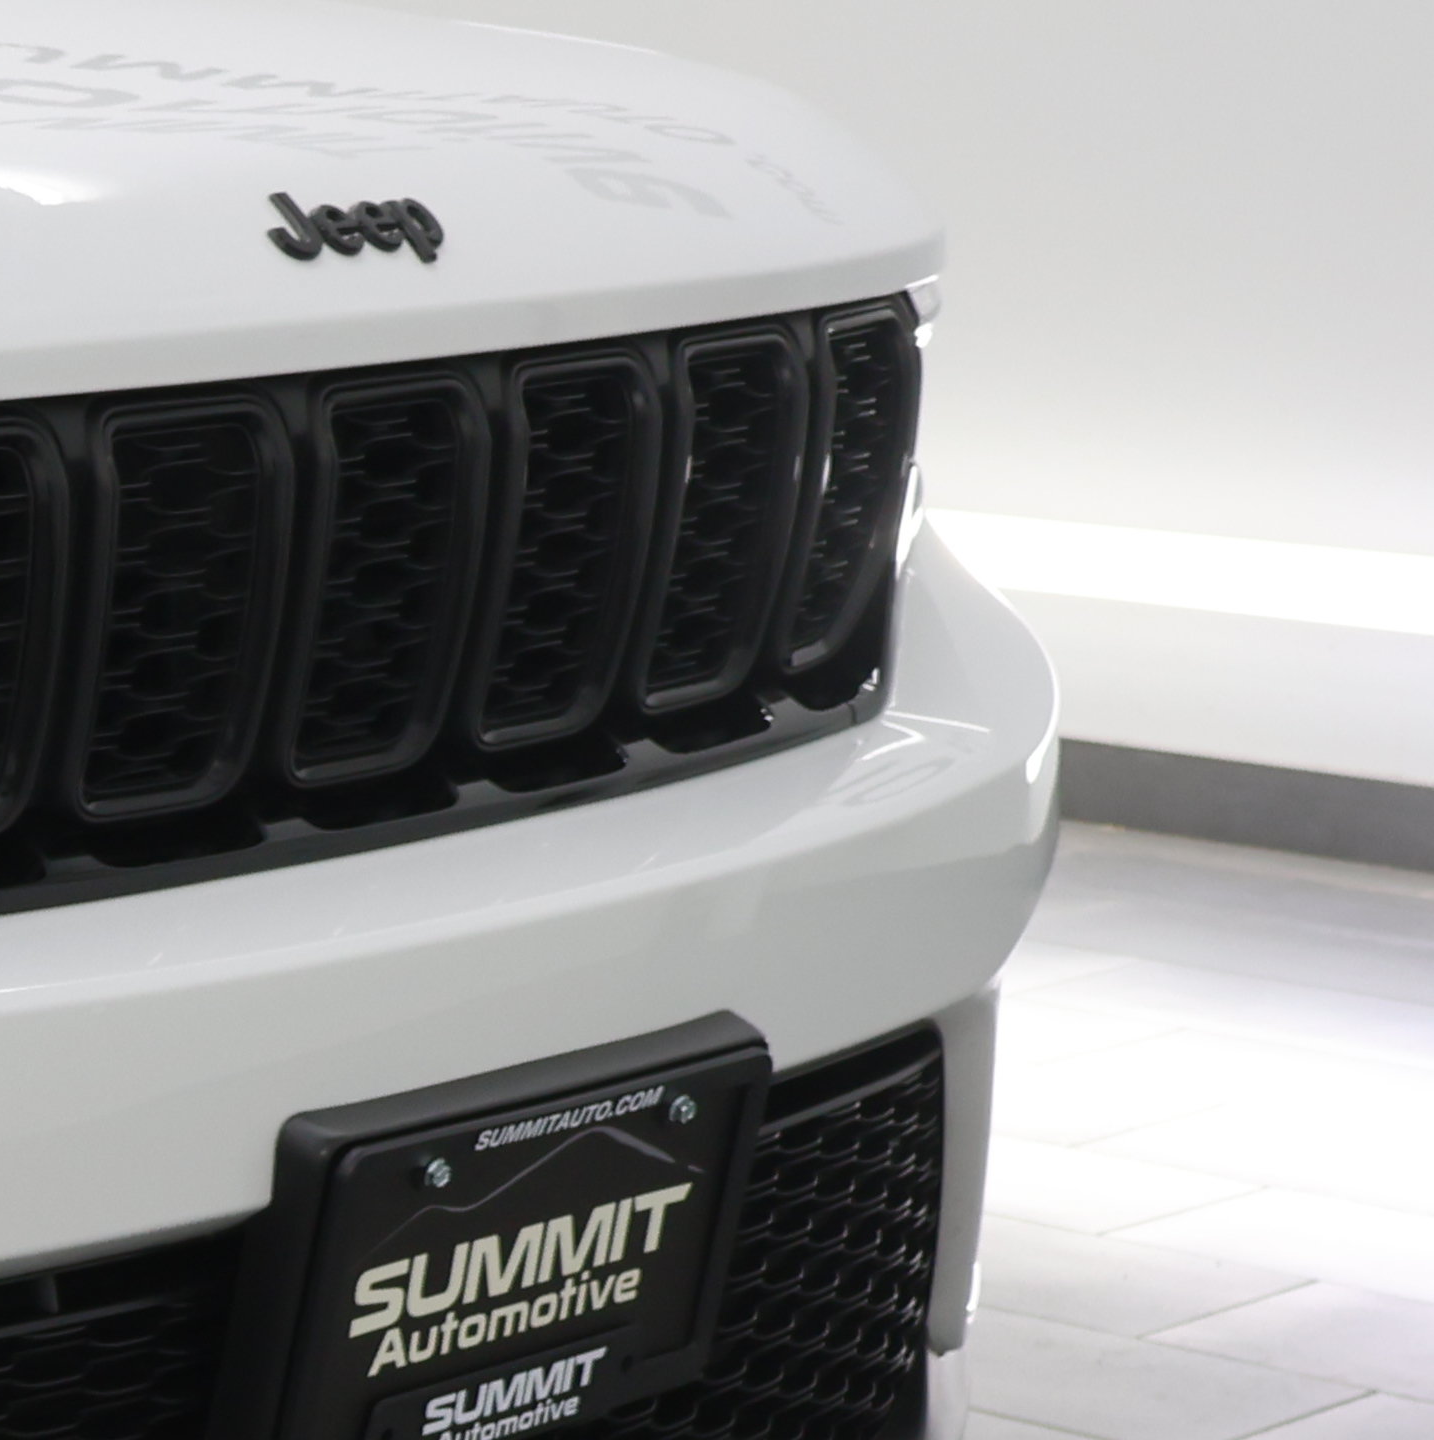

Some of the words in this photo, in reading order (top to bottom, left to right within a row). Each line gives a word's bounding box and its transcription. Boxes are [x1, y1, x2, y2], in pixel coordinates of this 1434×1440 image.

[266, 191, 444, 264] Jeep
[474, 1085, 665, 1151] SUMMITAUTO.COM
[348, 1181, 693, 1339] SUMMIT
[366, 1267, 642, 1378] Automotive
[421, 1345, 608, 1436] SUMMIT
